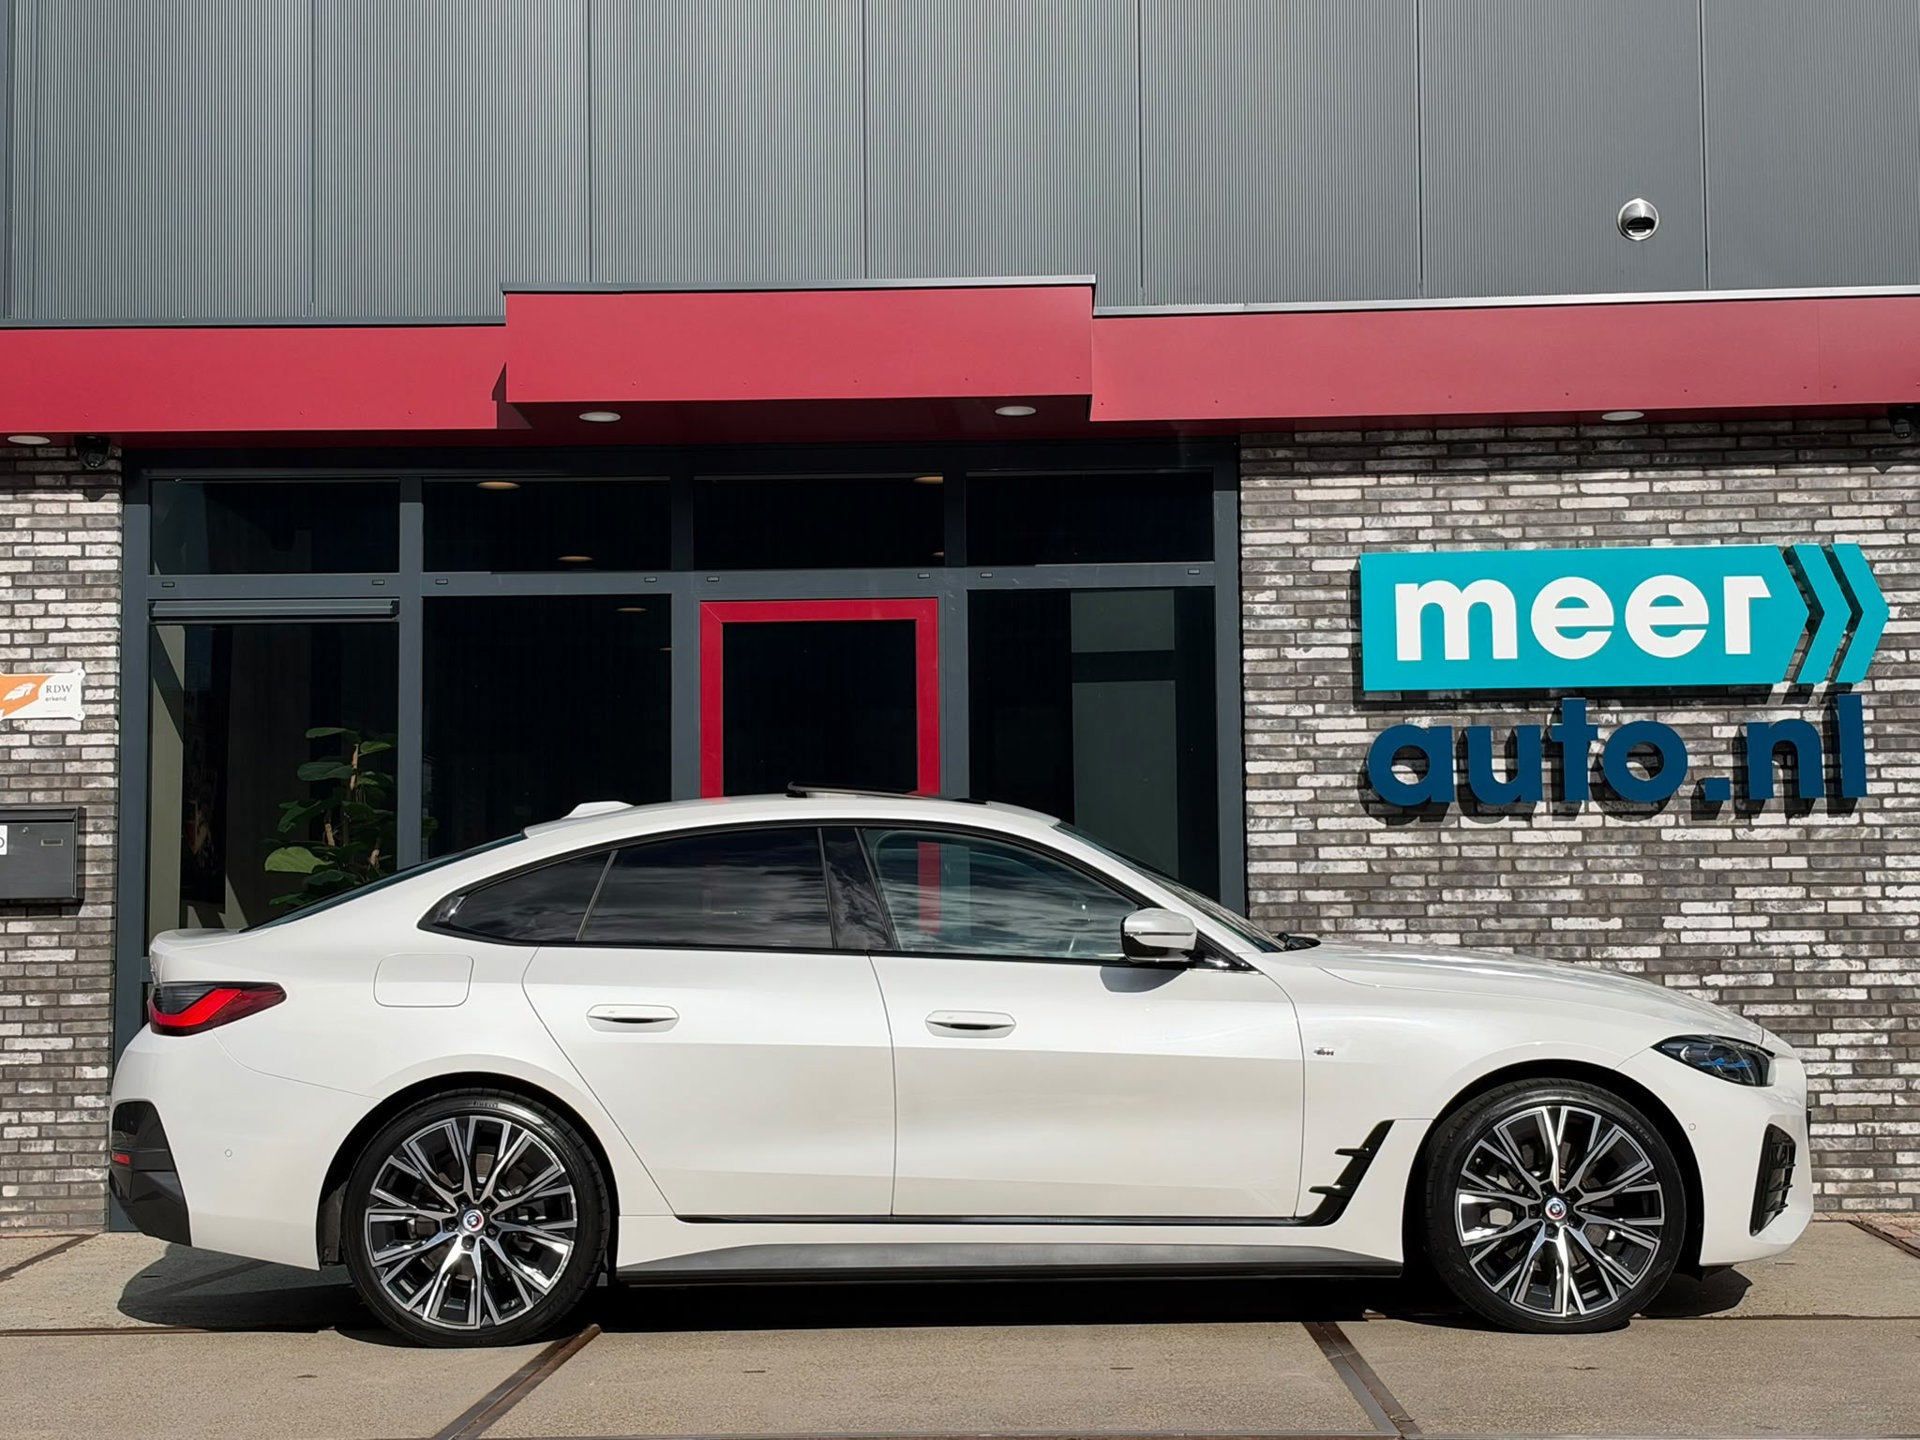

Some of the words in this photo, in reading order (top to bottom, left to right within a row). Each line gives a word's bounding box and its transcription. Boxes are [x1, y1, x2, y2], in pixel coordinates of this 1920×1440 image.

[1395, 575, 1772, 661] meer
[46, 684, 72, 693] RDW
[1368, 693, 1867, 805] auto.nl
